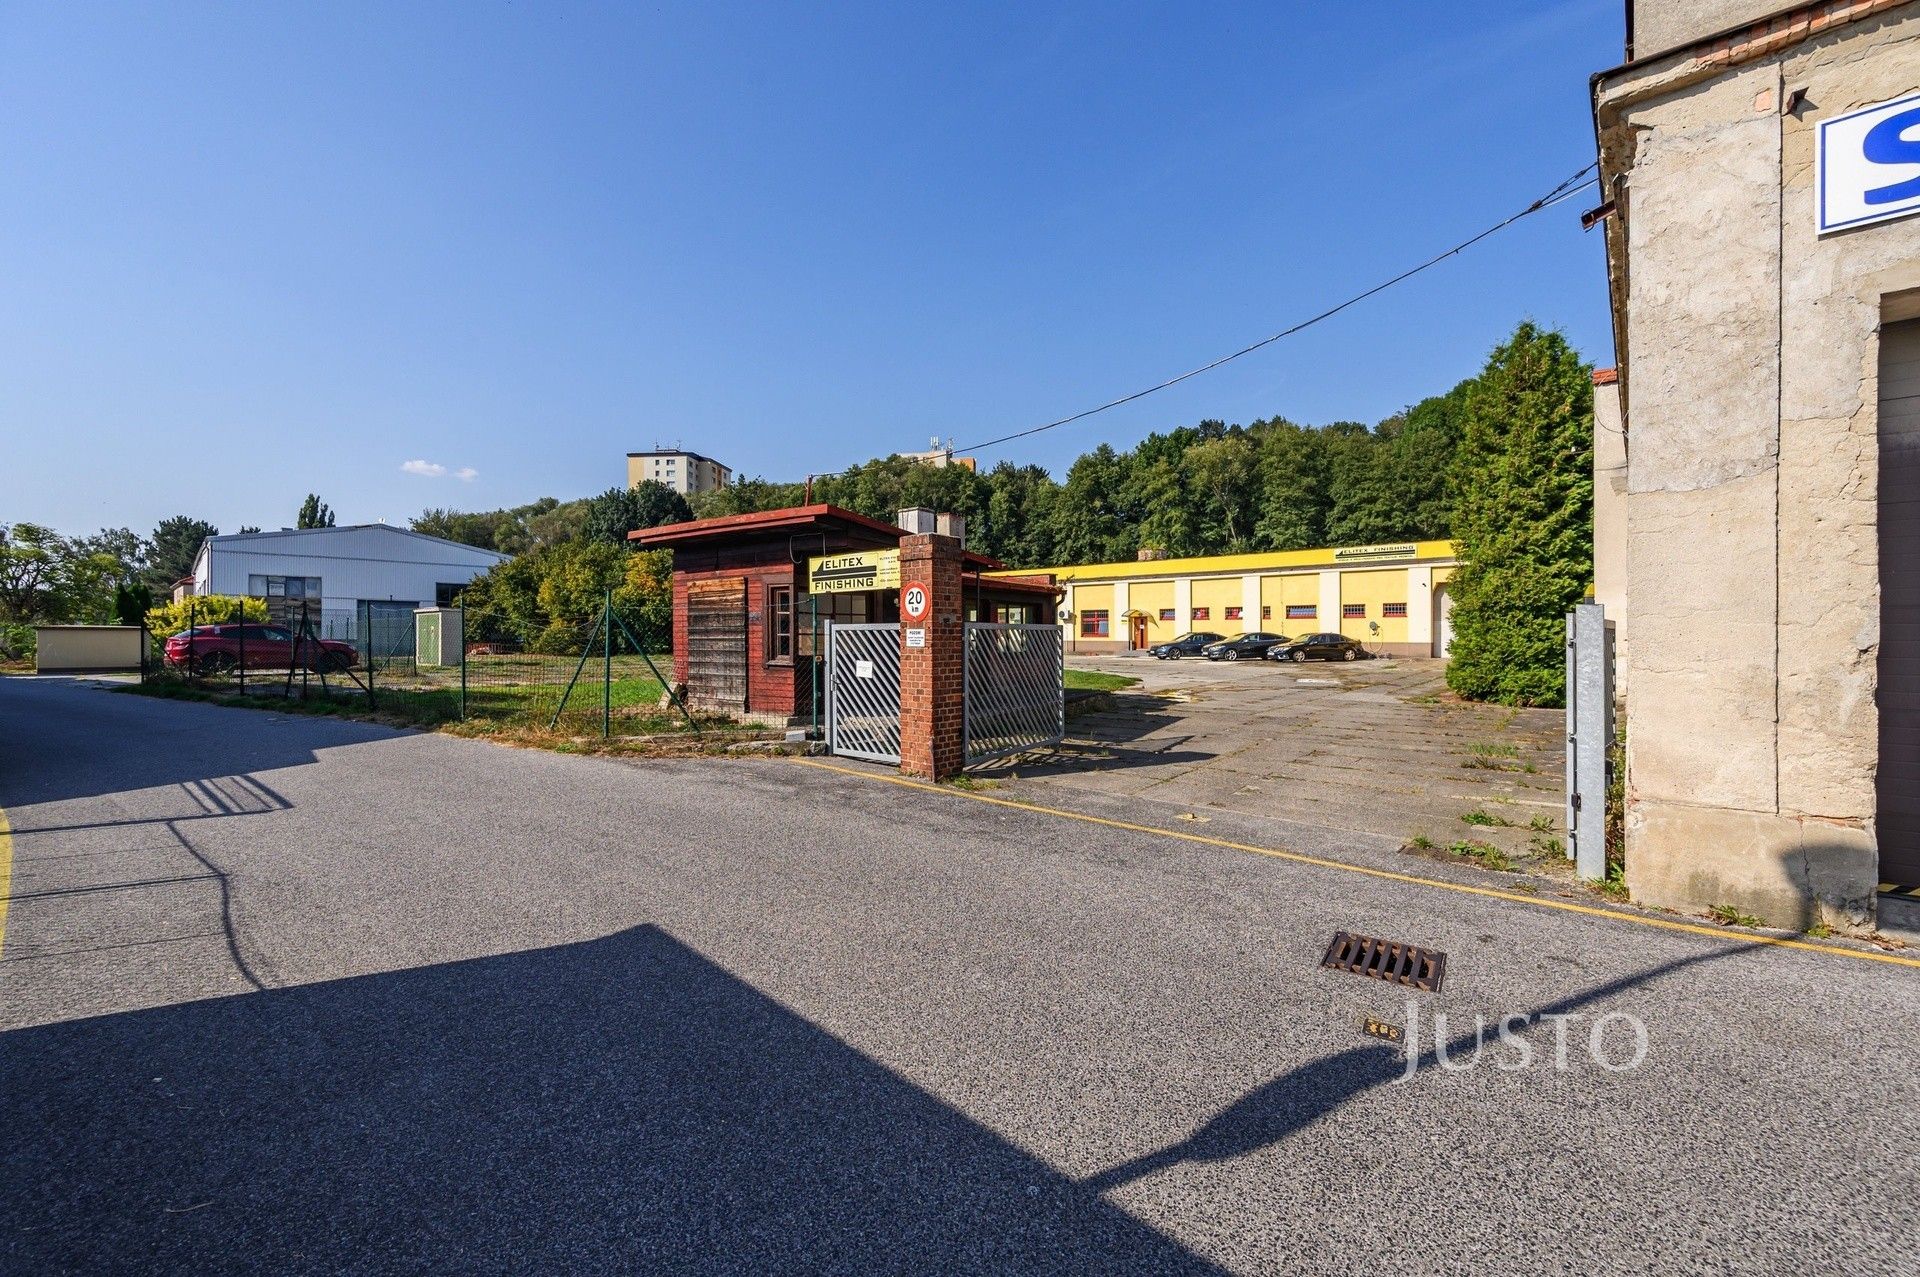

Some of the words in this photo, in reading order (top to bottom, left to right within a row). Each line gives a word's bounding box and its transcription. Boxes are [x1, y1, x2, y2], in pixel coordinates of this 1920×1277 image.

[825, 557, 863, 569] ELITEX
[815, 578, 874, 590] FINISHING
[908, 591, 922, 604] 20
